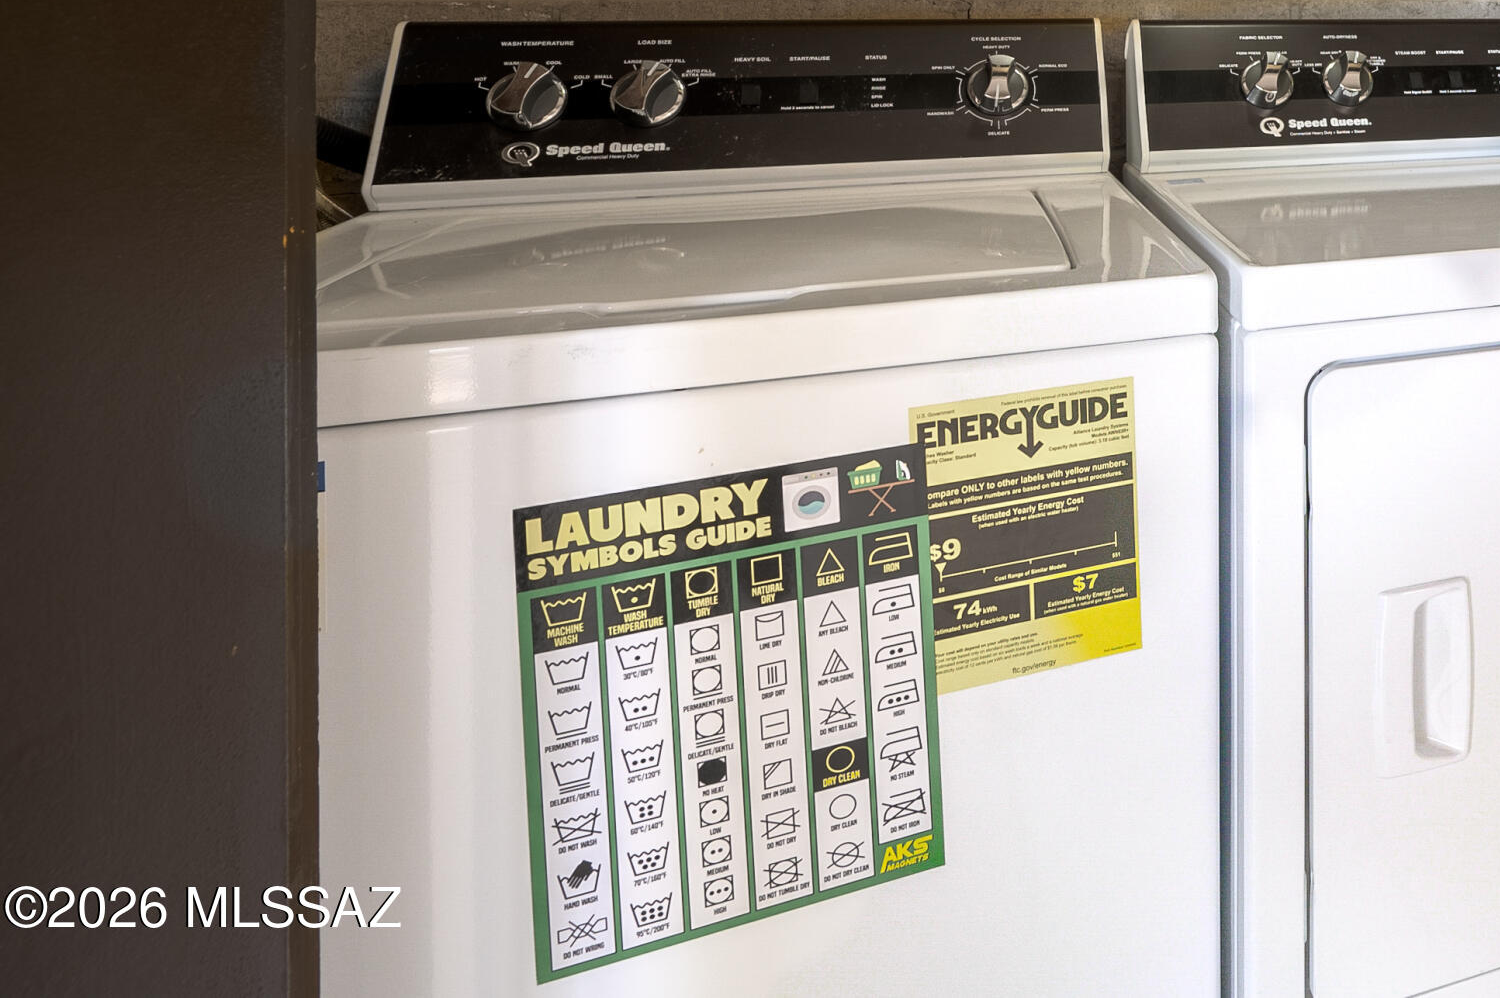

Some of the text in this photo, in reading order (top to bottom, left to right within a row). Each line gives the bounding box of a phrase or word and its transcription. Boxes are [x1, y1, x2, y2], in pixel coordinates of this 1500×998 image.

[1288, 118, 1328, 129] Speed
[546, 142, 604, 156] Speed
[917, 392, 1128, 448] ENERGYGUIDE
[927, 488, 959, 499] ompare
[961, 482, 984, 493] ONLY
[997, 478, 1018, 487] other
[1020, 472, 1044, 483] labels
[1046, 469, 1063, 478] with
[1065, 466, 1090, 477] yellow
[1092, 460, 1128, 471] numbers.
[963, 495, 982, 504] yellow
[984, 490, 1010, 498] numbers
[1022, 484, 1040, 492] based
[1090, 470, 1122, 481] procedures.
[525, 478, 768, 555] LAUNDRY
[972, 496, 1083, 524] Estimated Yearly Energy Cost
[528, 516, 772, 580] SYMBOLS GUIDE
[930, 538, 961, 562] $9
[883, 562, 899, 572] IRON
[817, 573, 843, 586] BLEACH
[1073, 574, 1099, 594] $7
[752, 582, 783, 596] NATURAL
[688, 596, 717, 609] TUMBLE
[761, 593, 774, 603] DRY
[1048, 597, 1074, 607] Estimated
[624, 610, 646, 622] WASH
[696, 607, 710, 617] DRY
[954, 600, 998, 620] 74 kWh
[608, 616, 662, 635] TEMPERATURE
[980, 615, 1008, 625] Electricity
[547, 623, 583, 638] MACHINE
[830, 625, 848, 634] BLEACH
[554, 634, 577, 646] WASH
[695, 654, 716, 663] NORMAL
[886, 660, 906, 669] MEDIUM
[1012, 659, 1056, 673] ftc.gov/energy
[818, 672, 853, 685] NON-CHLORINE
[557, 684, 580, 694] NORMAL
[761, 691, 773, 699] DRIP
[683, 695, 733, 712] PERMANENT PRESS
[838, 721, 857, 730] BLEACH
[544, 735, 598, 753] PERMANENT PRESS
[688, 743, 733, 759] DELICATE/GENTLE
[822, 770, 860, 787] DRY CLEAN
[898, 770, 914, 779] STEAM
[711, 786, 723, 794] HEAT
[779, 786, 795, 795] SHADE
[550, 789, 599, 807] DELICATE/GENTLE
[842, 819, 857, 828] CLEAN
[568, 843, 578, 851] NOT
[580, 839, 596, 848] WASH
[880, 834, 933, 873] AKS
[854, 865, 868, 873] CLEAN
[887, 853, 929, 872] MAGNETS
[707, 865, 728, 875] MEDIUM
[778, 885, 798, 895] TUMBLE
[564, 896, 597, 910] HAND WASH
[563, 942, 604, 959] DO NOT WRING
